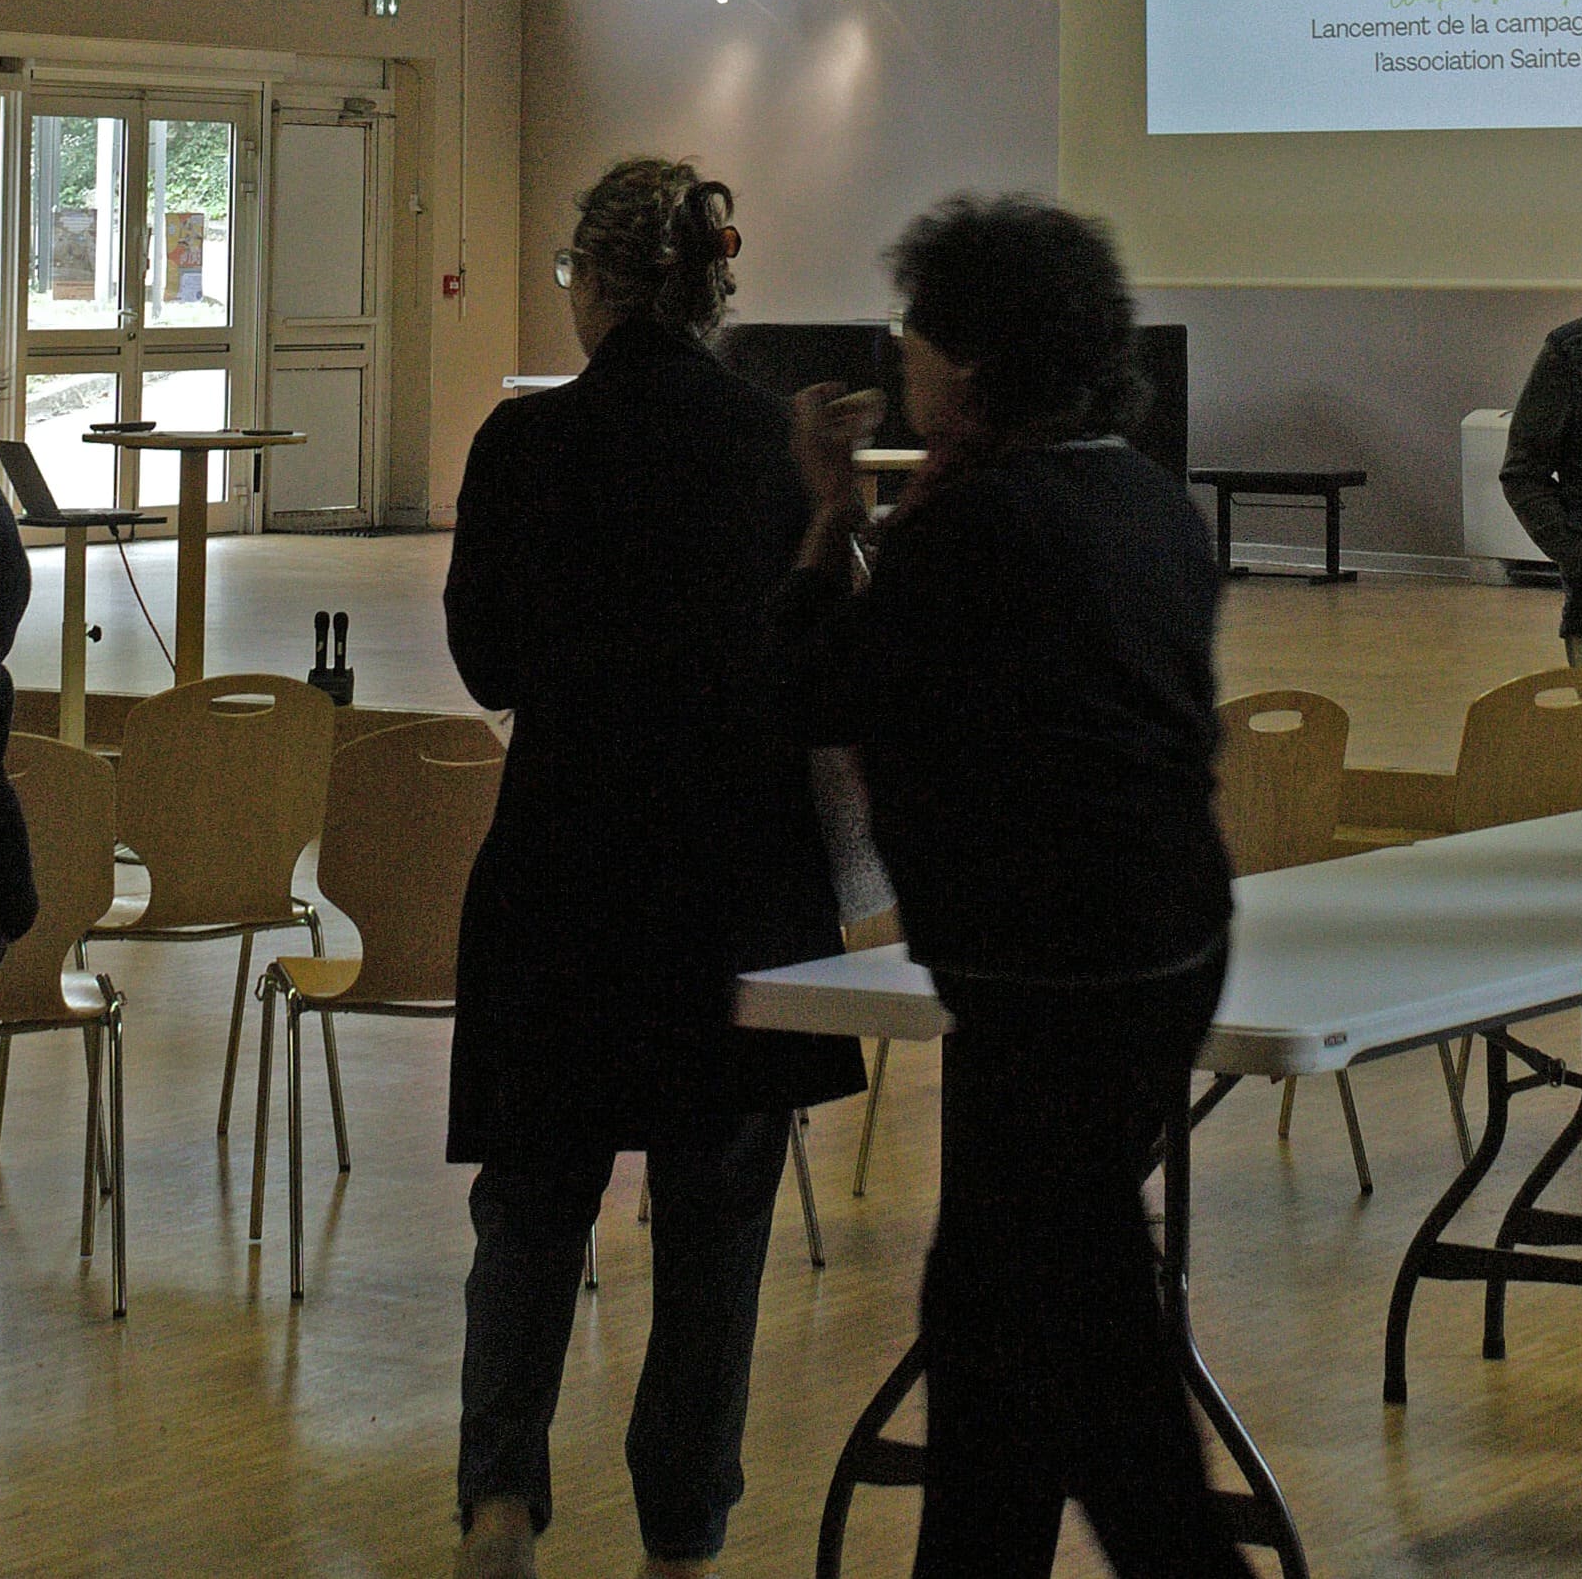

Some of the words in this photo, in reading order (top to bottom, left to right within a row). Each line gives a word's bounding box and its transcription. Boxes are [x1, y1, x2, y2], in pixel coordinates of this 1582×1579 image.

[1311, 16, 1432, 39] Lancement
[1437, 14, 1465, 35] de
[1470, 13, 1490, 34] la
[1374, 50, 1505, 73] l'association
